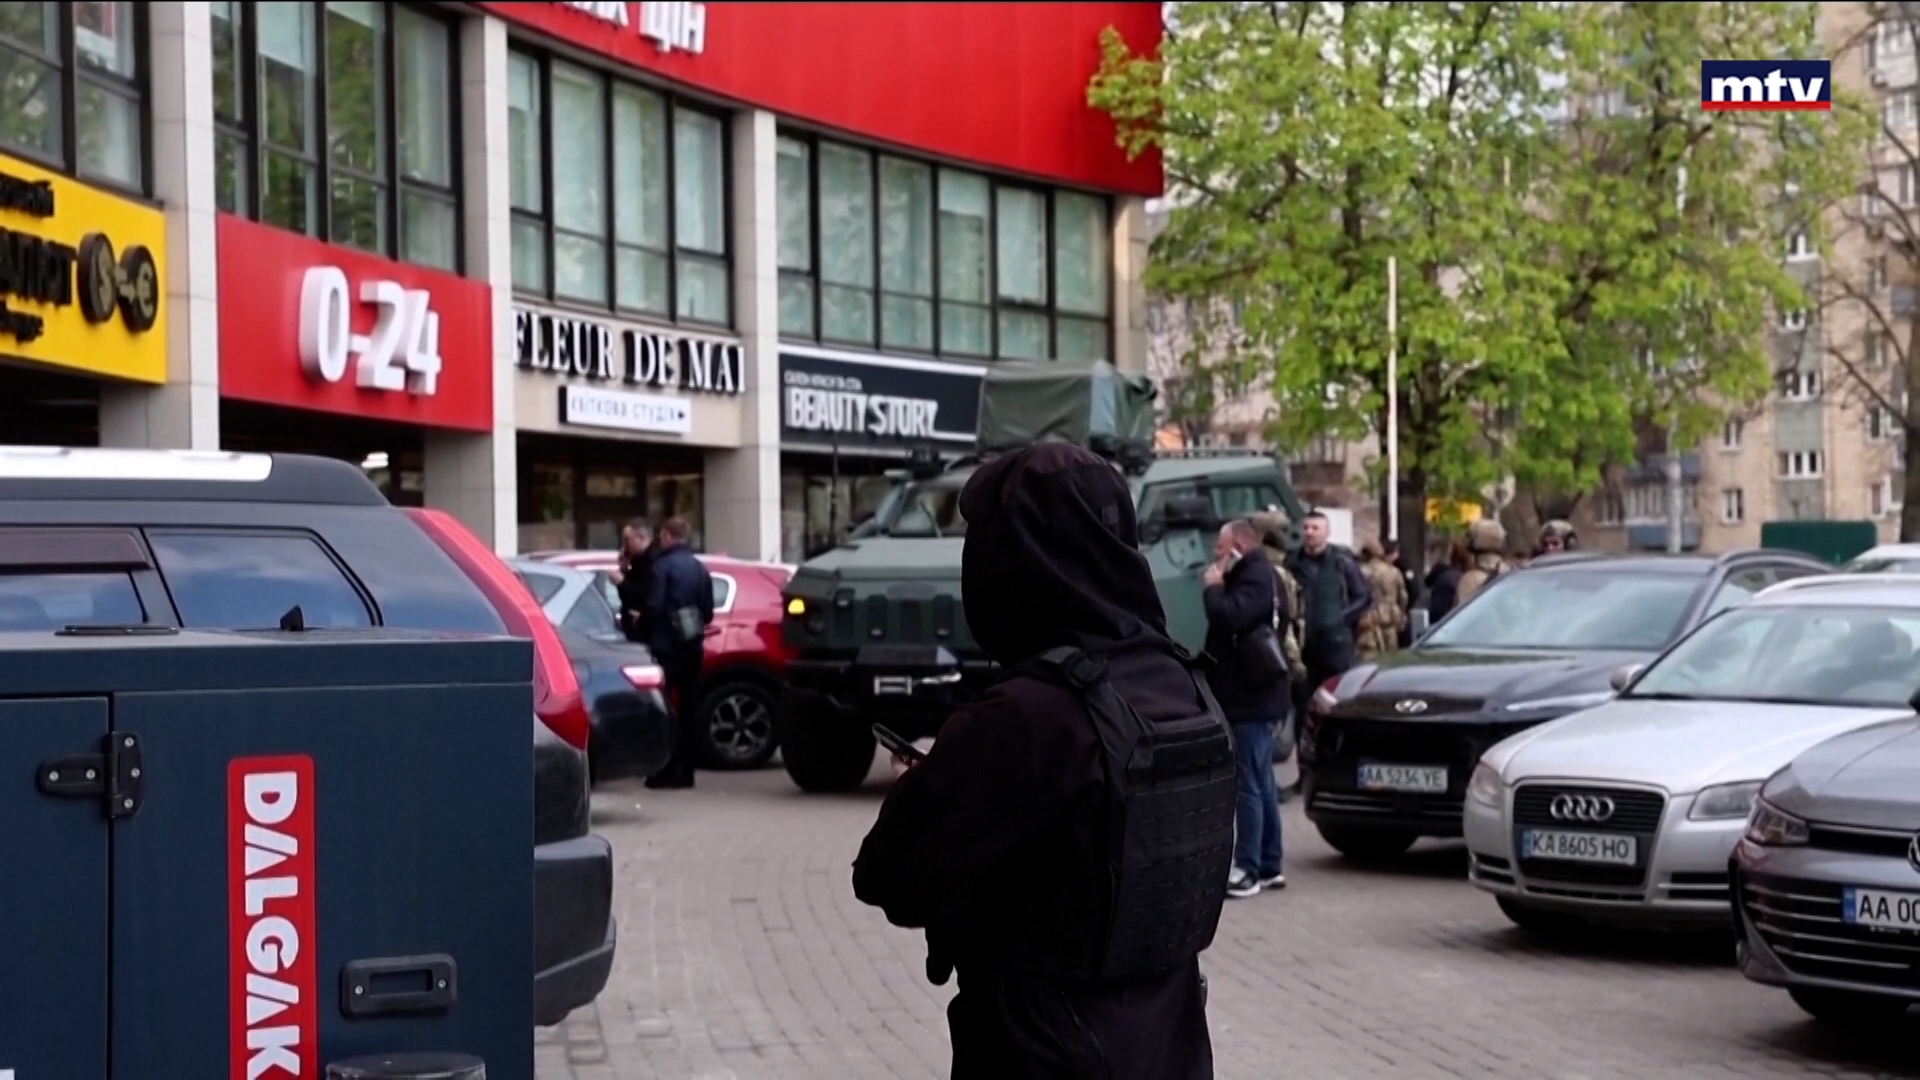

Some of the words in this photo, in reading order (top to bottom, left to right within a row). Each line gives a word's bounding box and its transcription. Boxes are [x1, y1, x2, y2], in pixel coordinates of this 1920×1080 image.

[299, 266, 441, 395] 0-24
[513, 311, 616, 378] FLEUR
[633, 331, 677, 385] DE
[786, 387, 867, 432] BEAUTY
[868, 394, 940, 437] STORY
[1532, 832, 1554, 852] KA
[1559, 835, 1598, 856] 8605
[1602, 838, 1629, 859] HO
[244, 771, 300, 1080] DALGAK
[1859, 893, 1891, 921] AA
